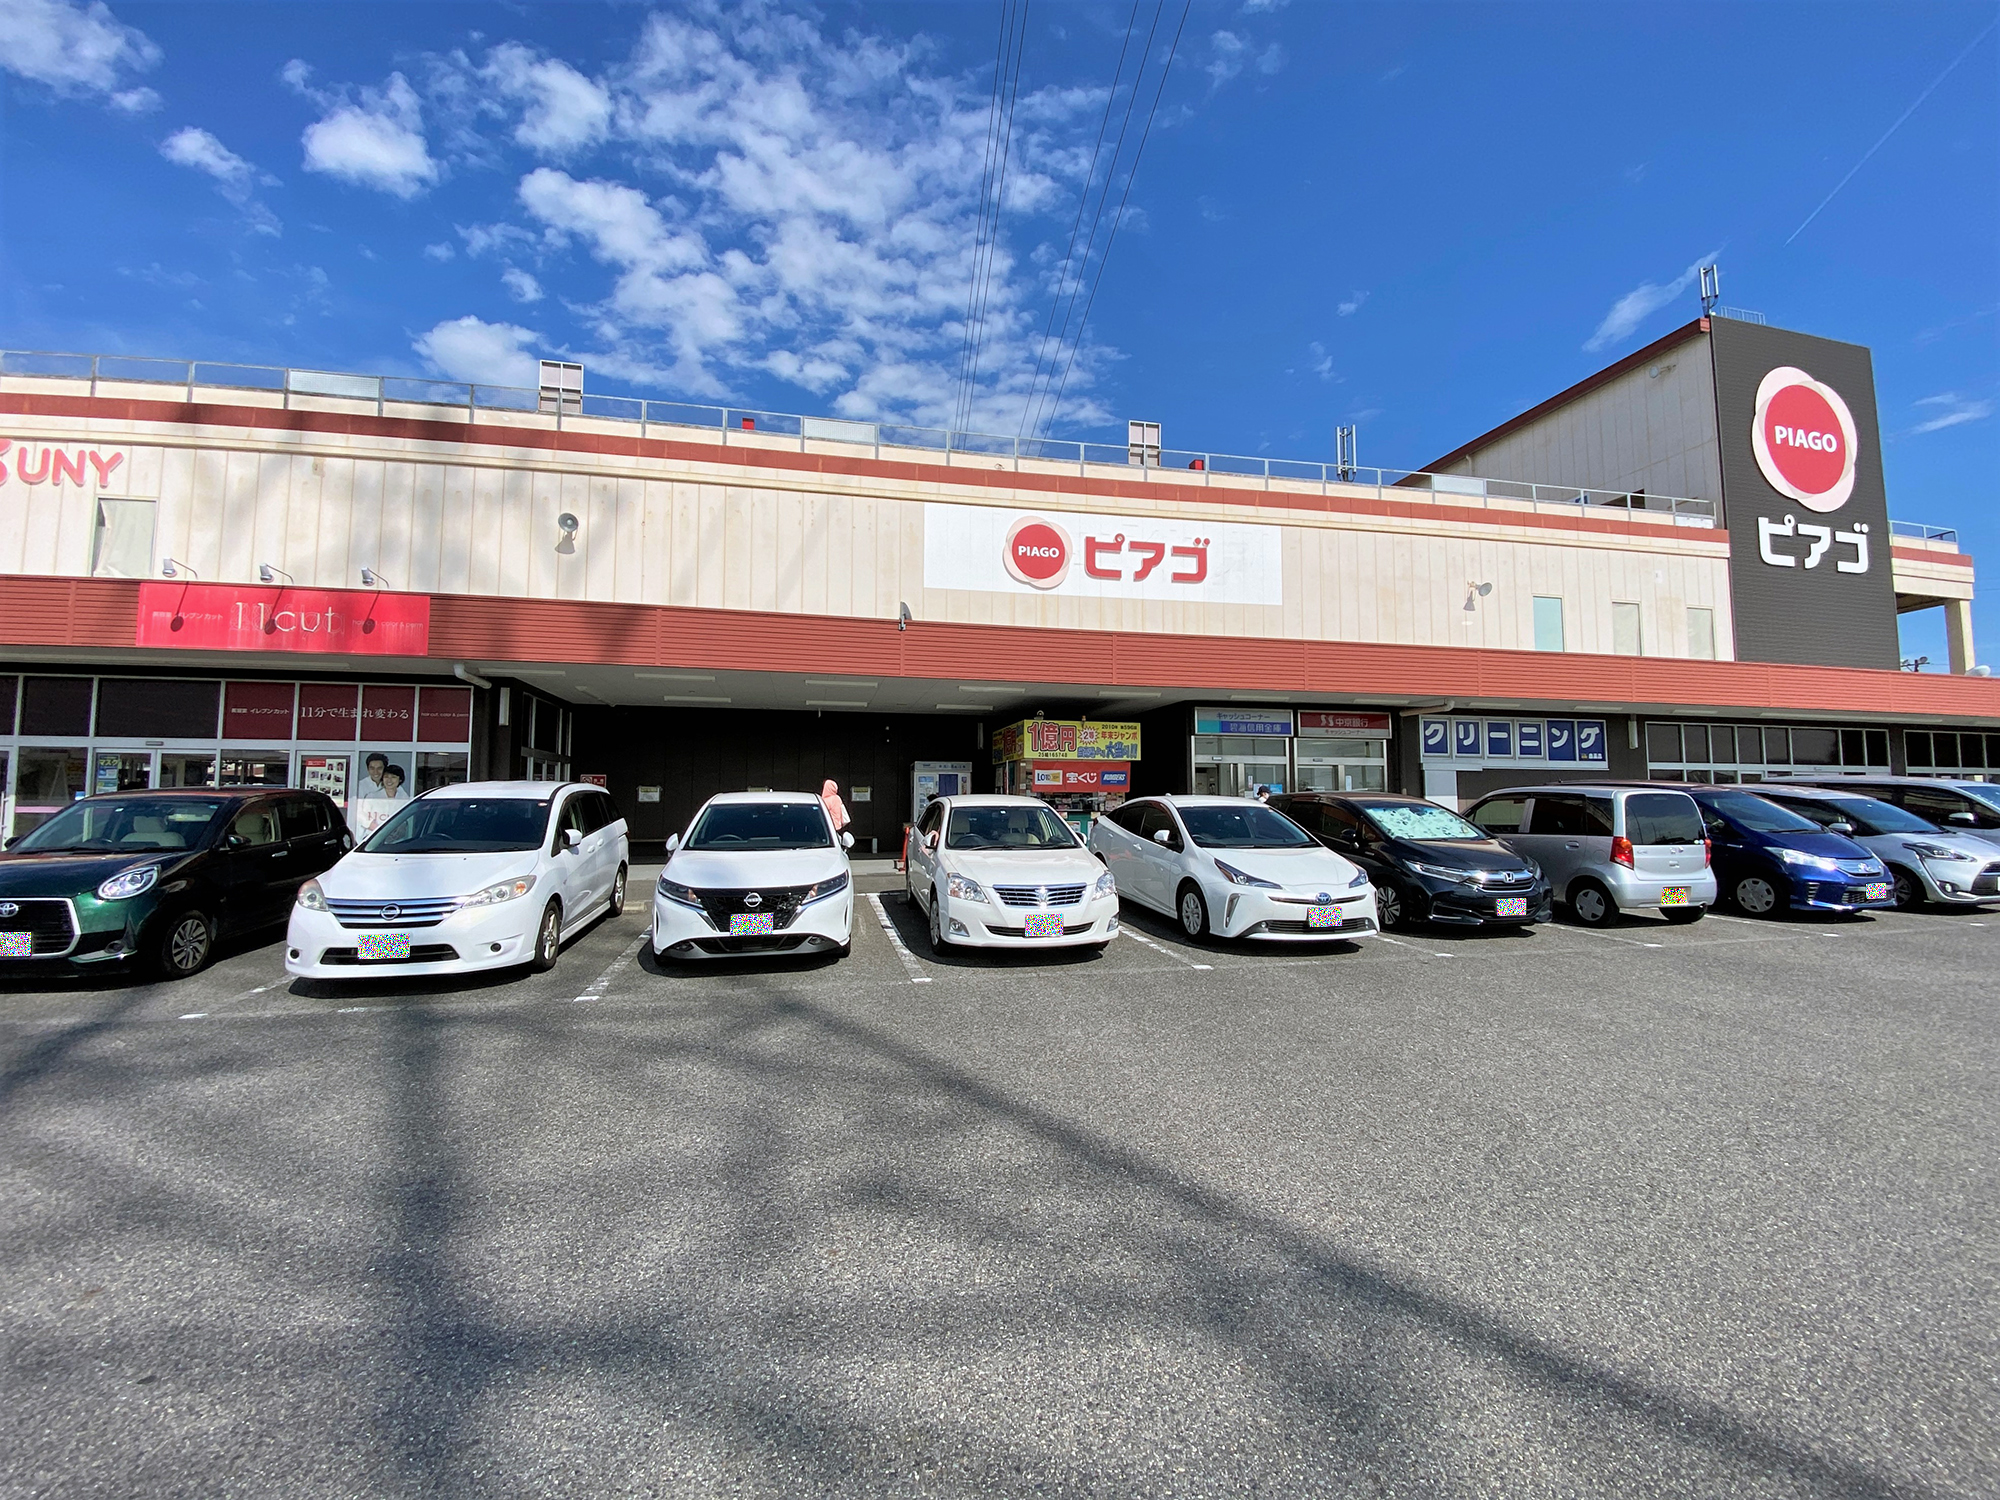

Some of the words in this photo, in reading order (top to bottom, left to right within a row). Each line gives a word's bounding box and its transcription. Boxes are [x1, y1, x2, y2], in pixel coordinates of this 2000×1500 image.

[1774, 425, 1838, 453] PIAGO
[17, 446, 125, 489] UNY
[1018, 545, 1060, 559] PIAGO
[1757, 514, 1870, 574] ピアゴ
[1084, 532, 1211, 584] ピアゴ
[236, 602, 336, 632] 11cut
[300, 706, 410, 720] 11分で生まれ変わる
[1217, 712, 1271, 720] キャッシュコーナー
[1335, 718, 1369, 728] 中京銀行
[1027, 721, 1077, 751] 1億円
[1424, 723, 1600, 749] クリーニング
[1066, 772, 1097, 783] 宝くじ
